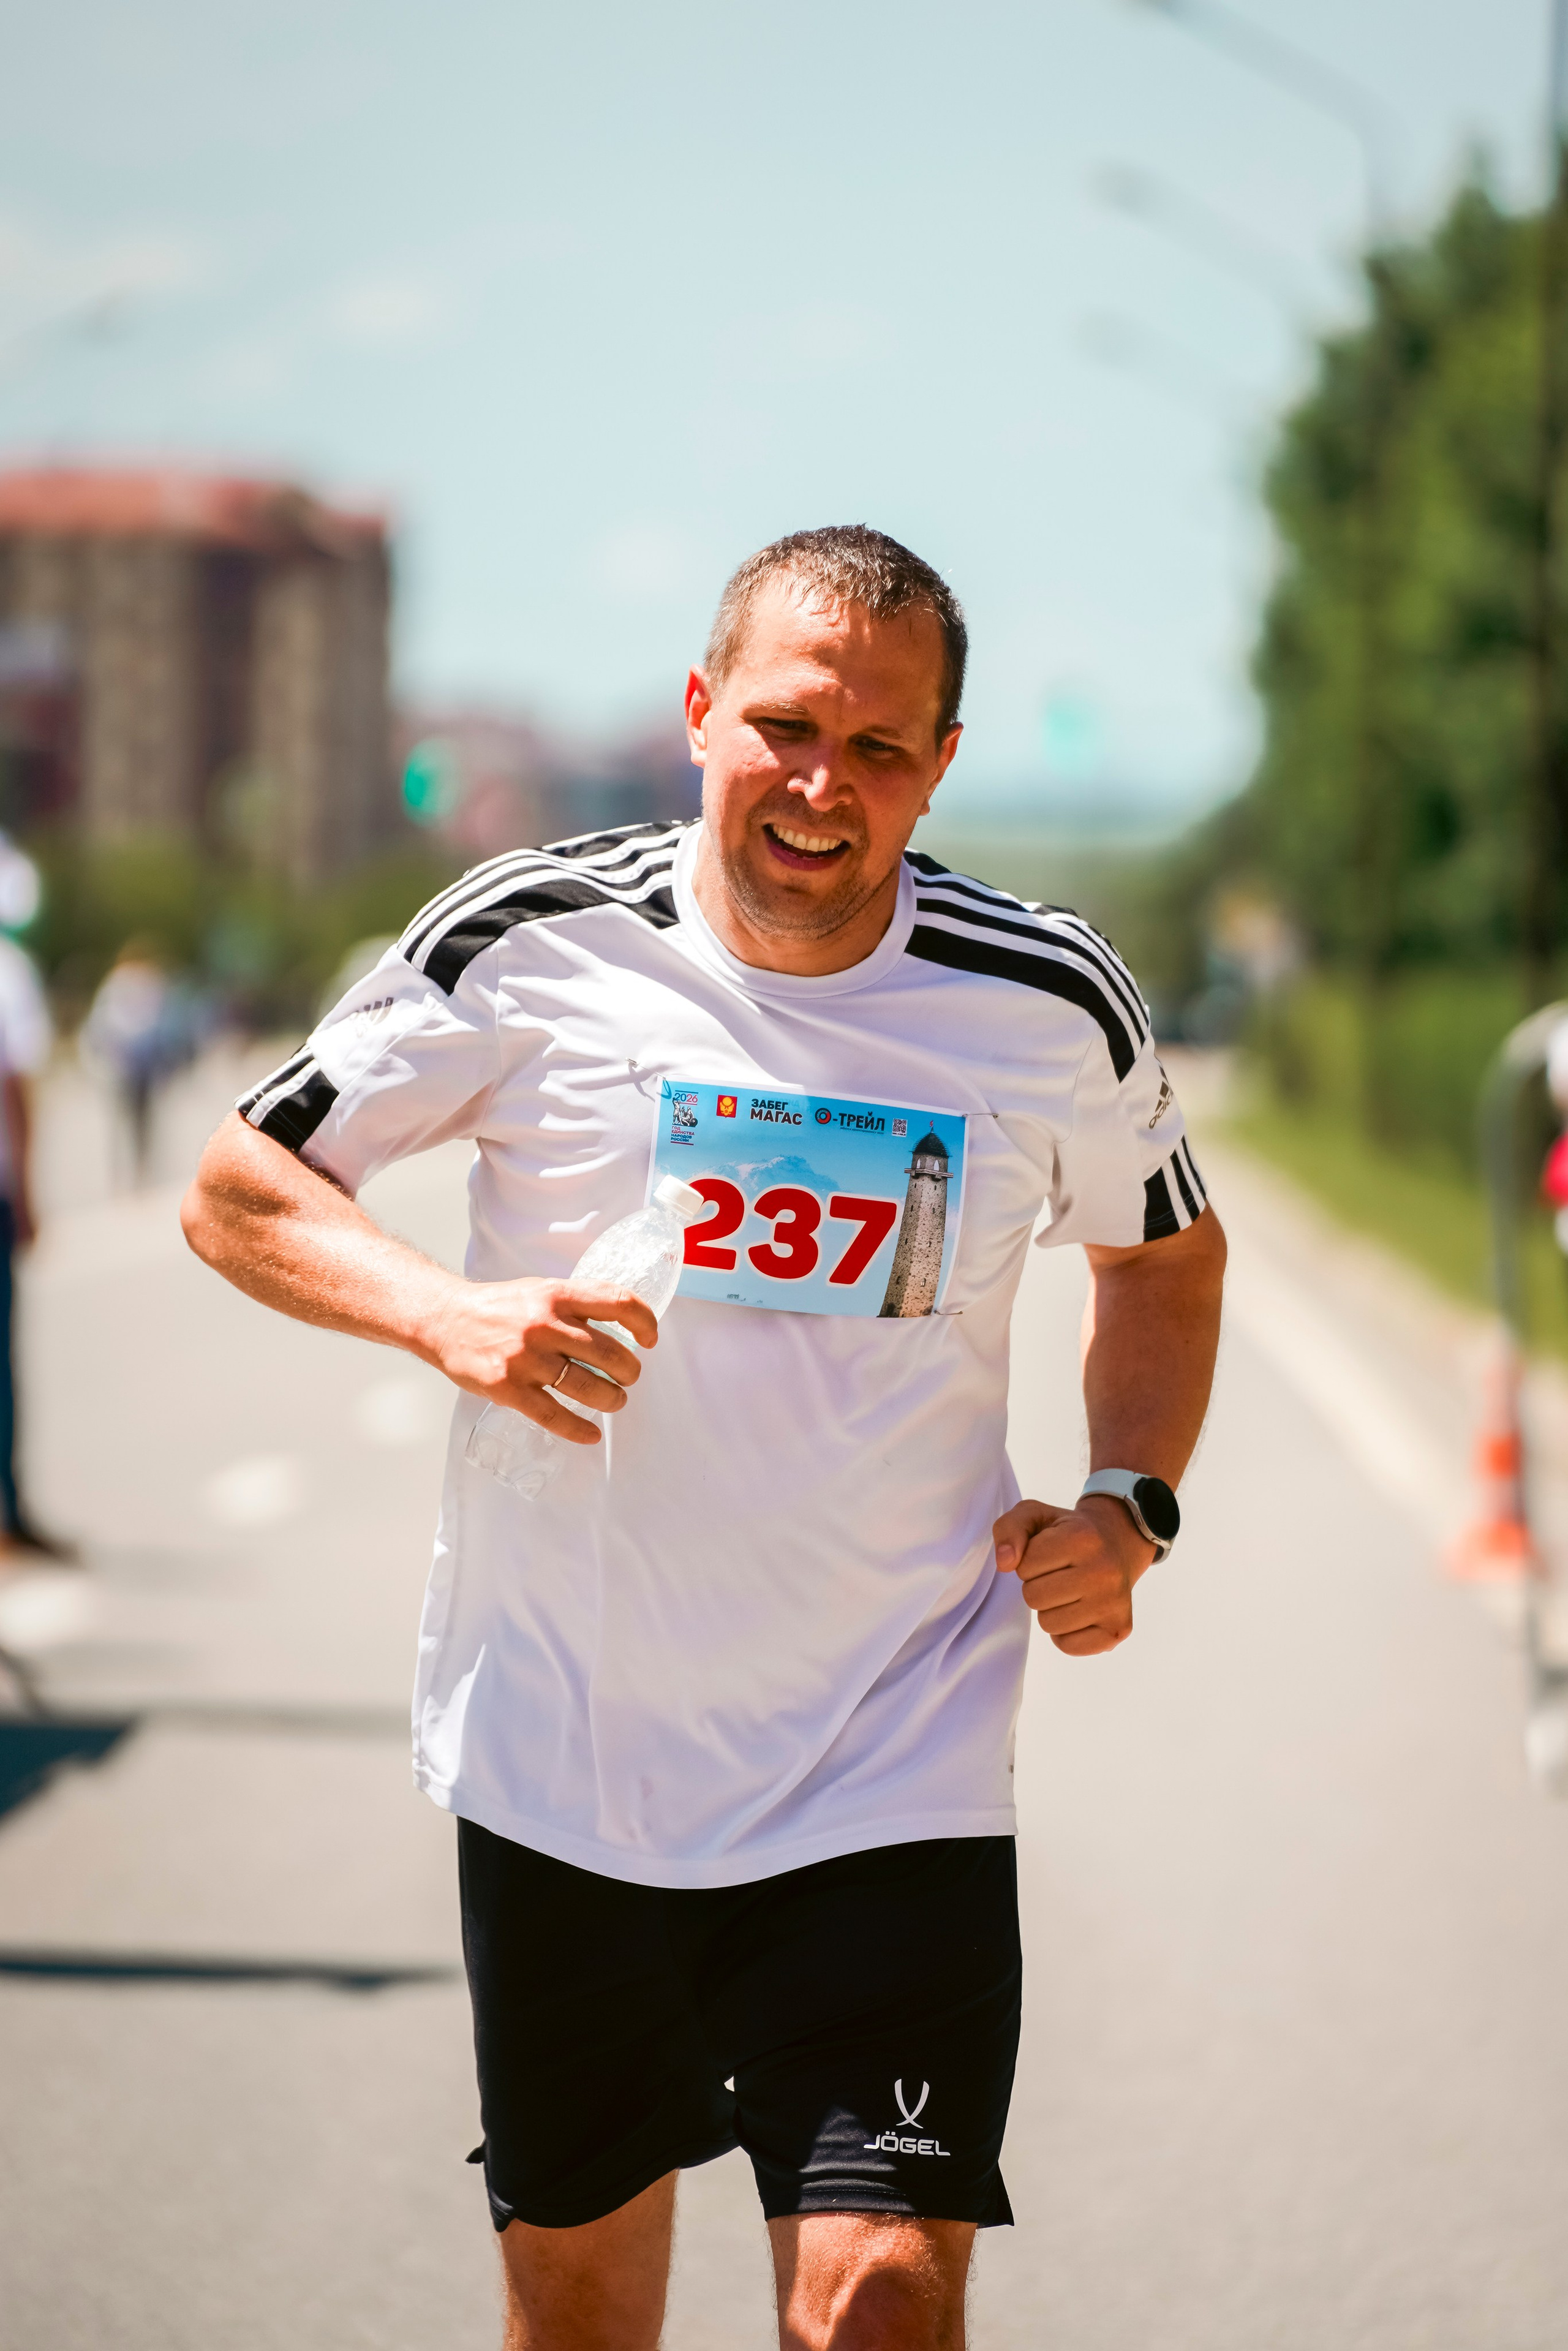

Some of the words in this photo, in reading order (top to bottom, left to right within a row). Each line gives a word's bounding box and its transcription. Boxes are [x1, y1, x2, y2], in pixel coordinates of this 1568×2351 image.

[674, 1093, 698, 1103] 2026
[751, 1098, 788, 1111] ЗАБЕГ
[750, 1108, 802, 1125] МАГАС
[684, 1179, 897, 1285] 237
[864, 2130, 951, 2156] JÖGEL
